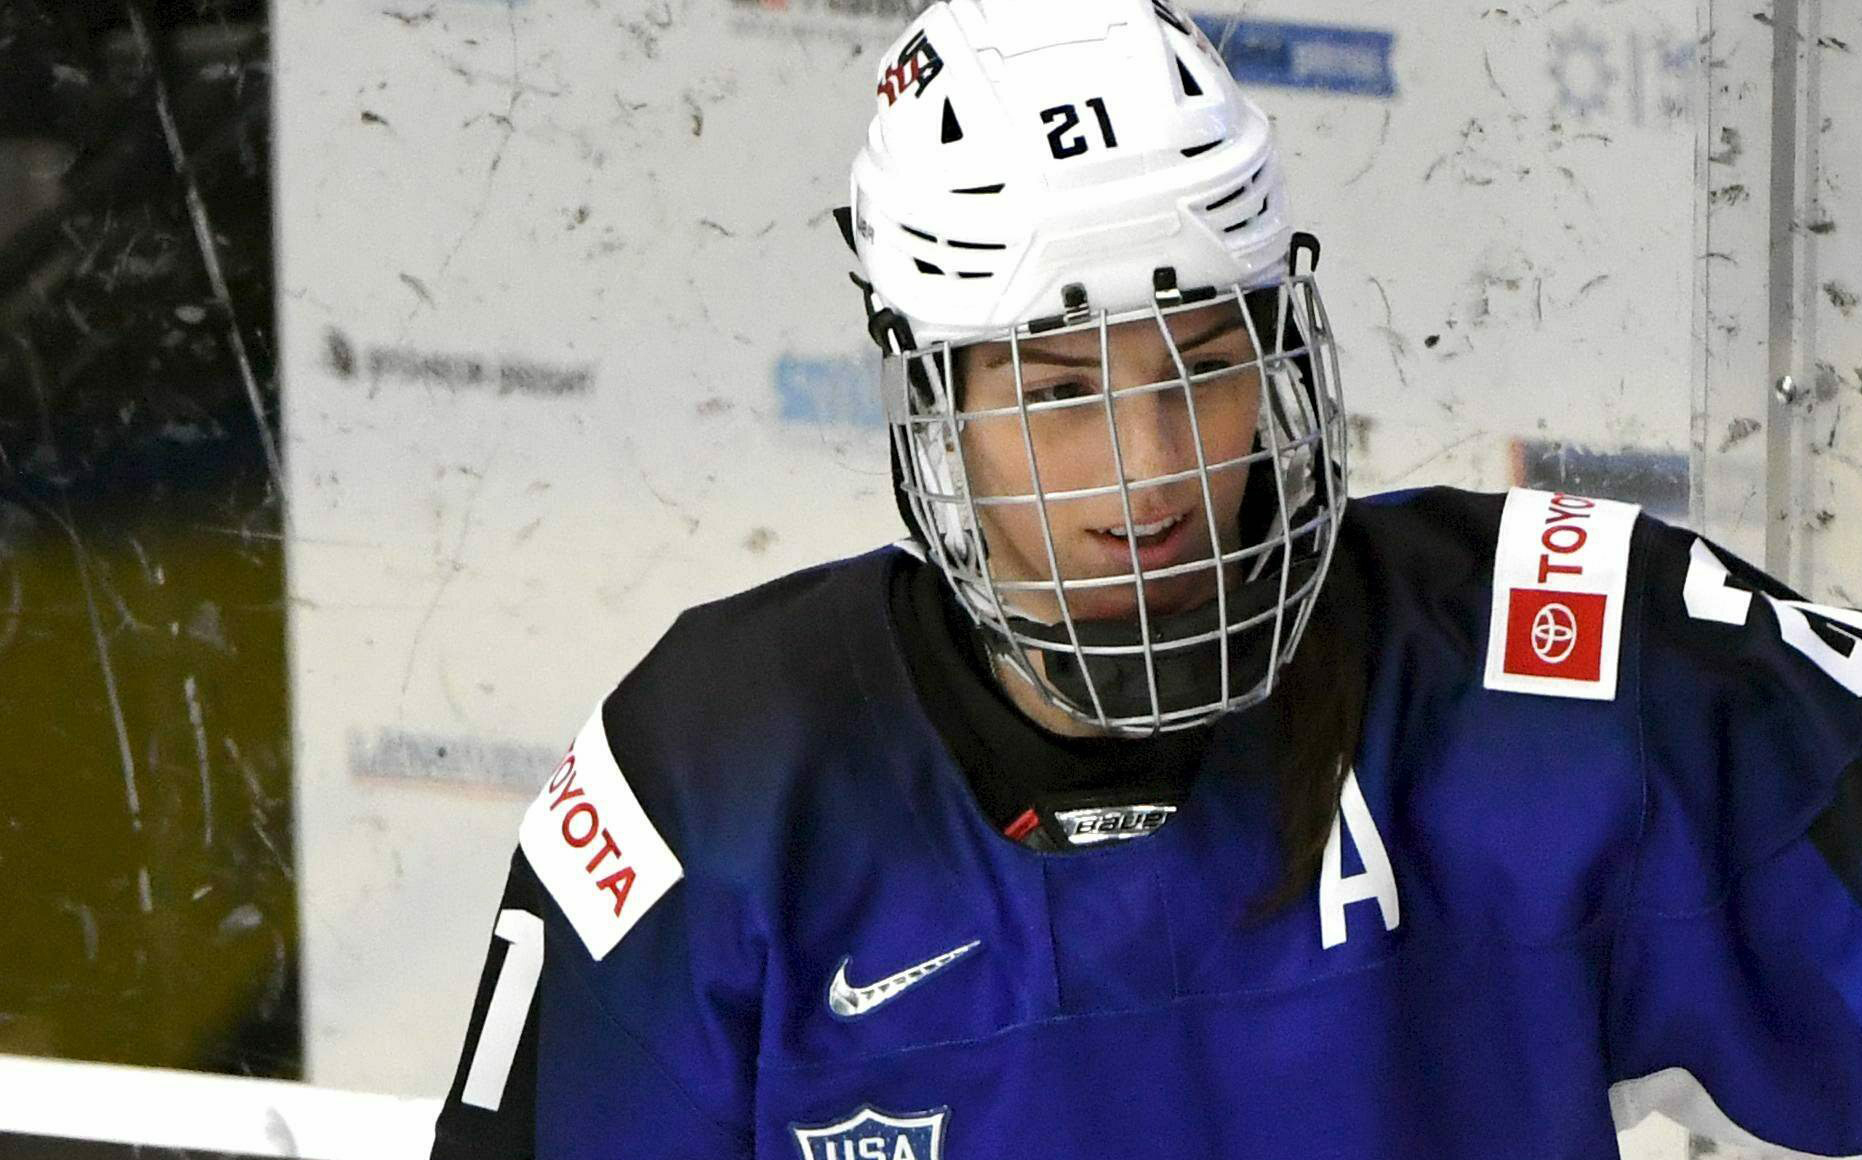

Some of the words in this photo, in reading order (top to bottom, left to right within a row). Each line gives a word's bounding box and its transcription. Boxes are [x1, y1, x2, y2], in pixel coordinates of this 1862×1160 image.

[1041, 97, 1117, 159] 21
[549, 737, 636, 918] OYOTA
[1319, 767, 1399, 948] A
